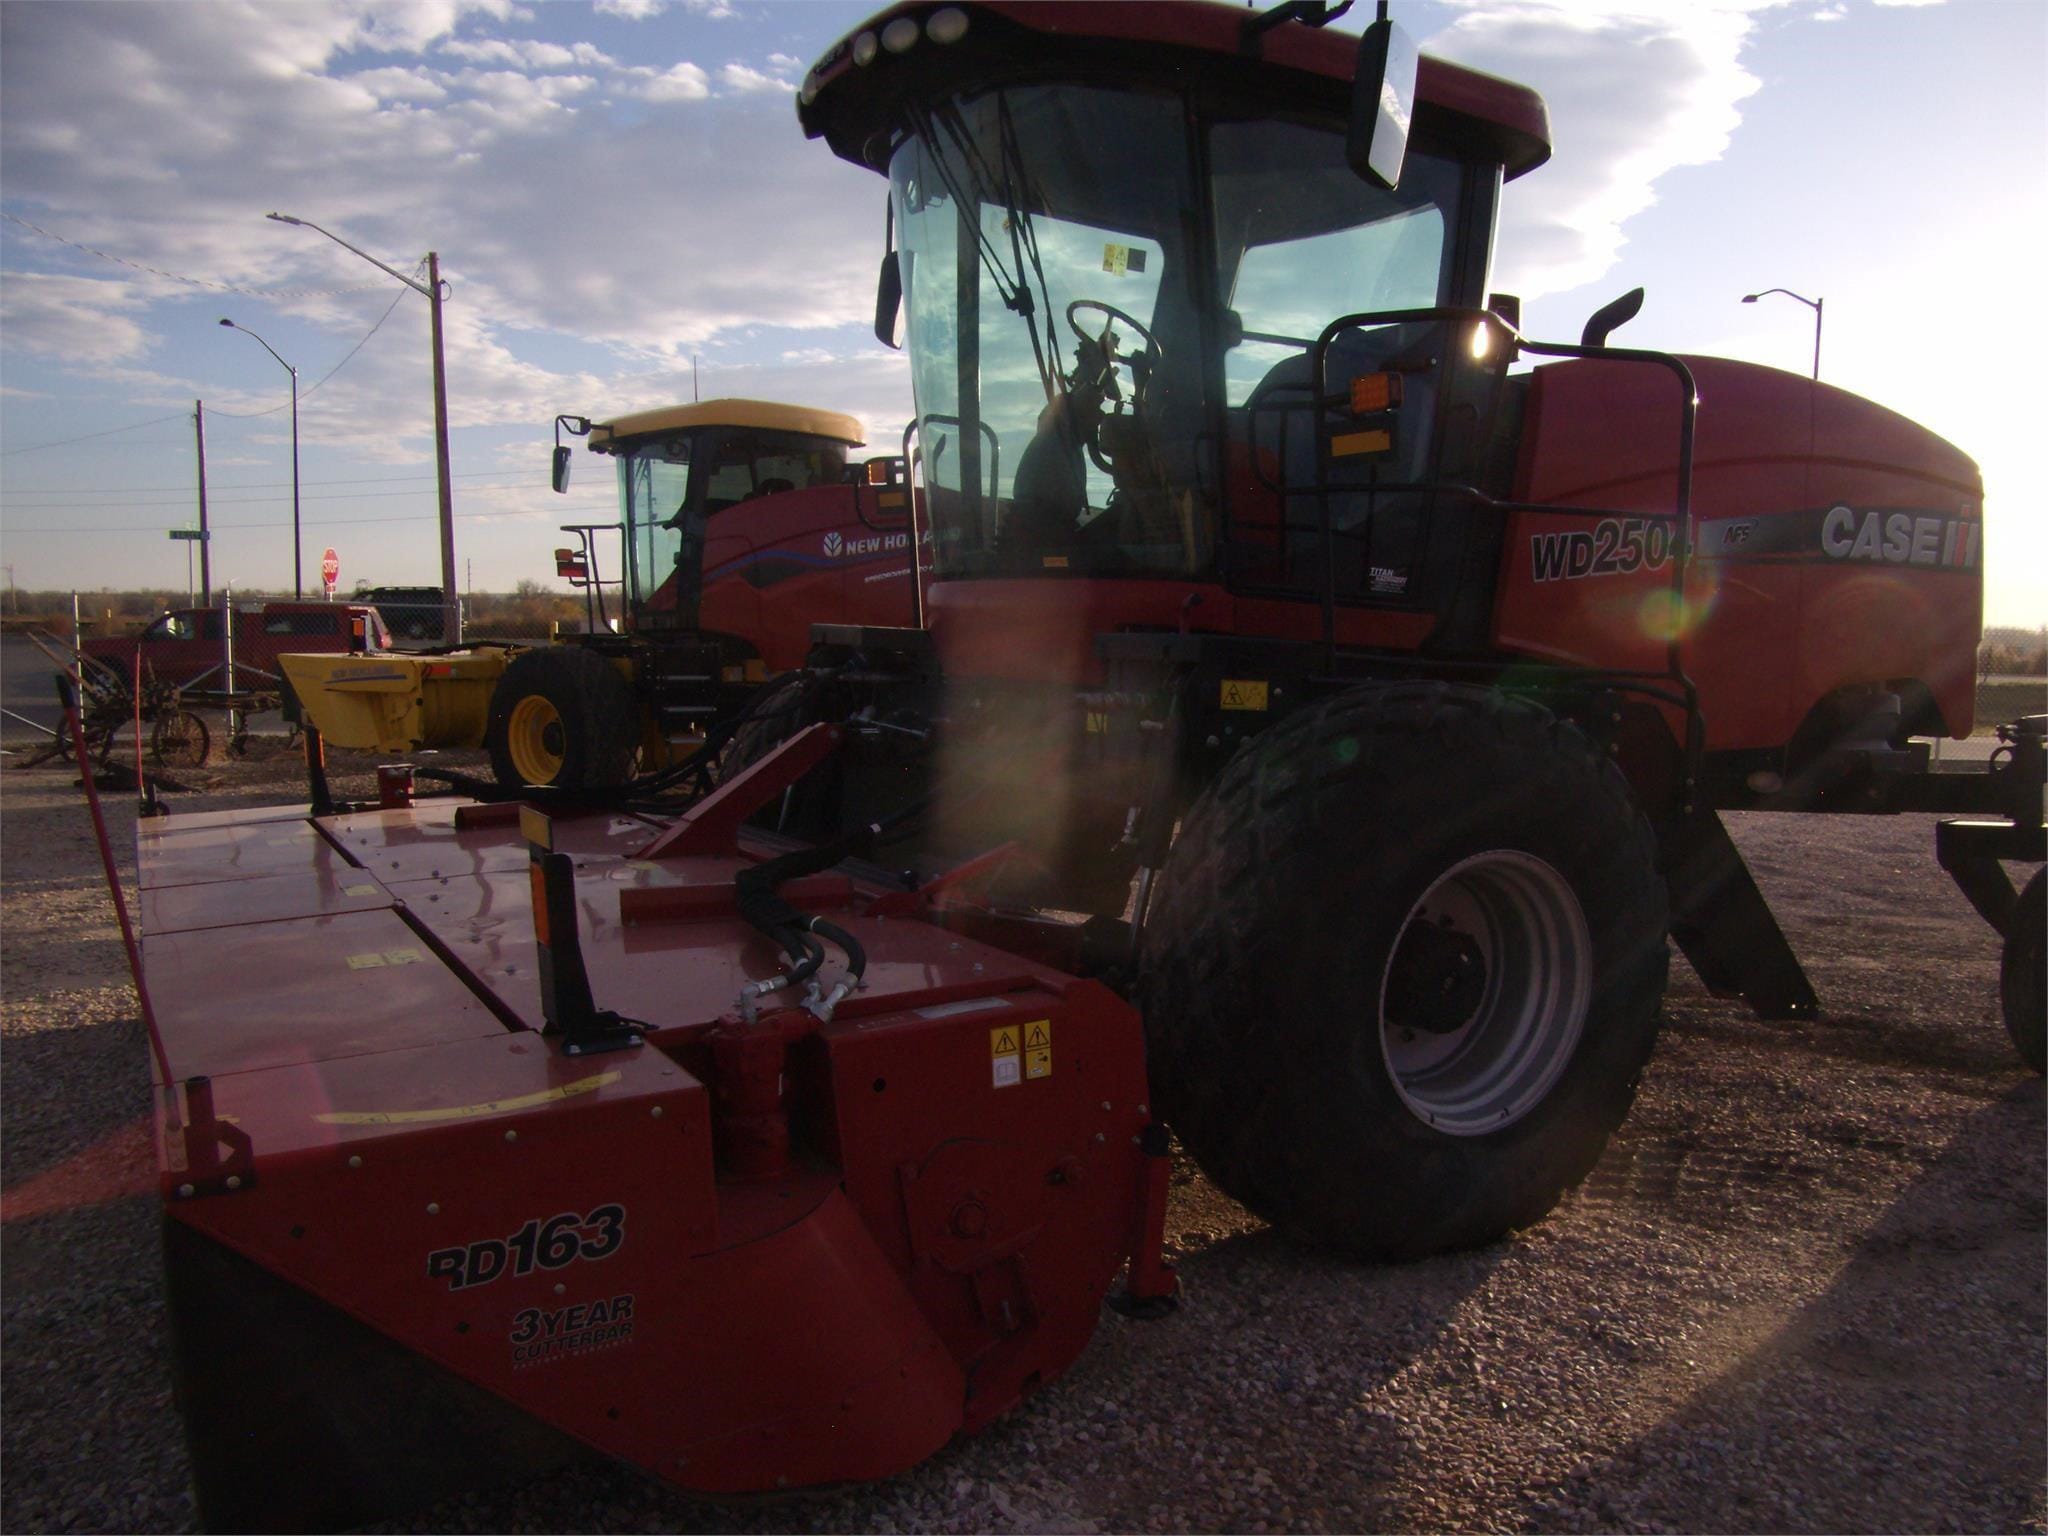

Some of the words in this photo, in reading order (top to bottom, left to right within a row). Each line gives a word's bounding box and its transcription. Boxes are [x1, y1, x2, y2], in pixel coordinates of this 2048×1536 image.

[846, 537, 880, 556] NEW
[1822, 506, 1941, 565] CASE
[323, 559, 338, 573] STOP
[1369, 567, 1394, 576] TITAN
[427, 1202, 627, 1292] RD163
[513, 1322, 634, 1362] CUTTERBAR
